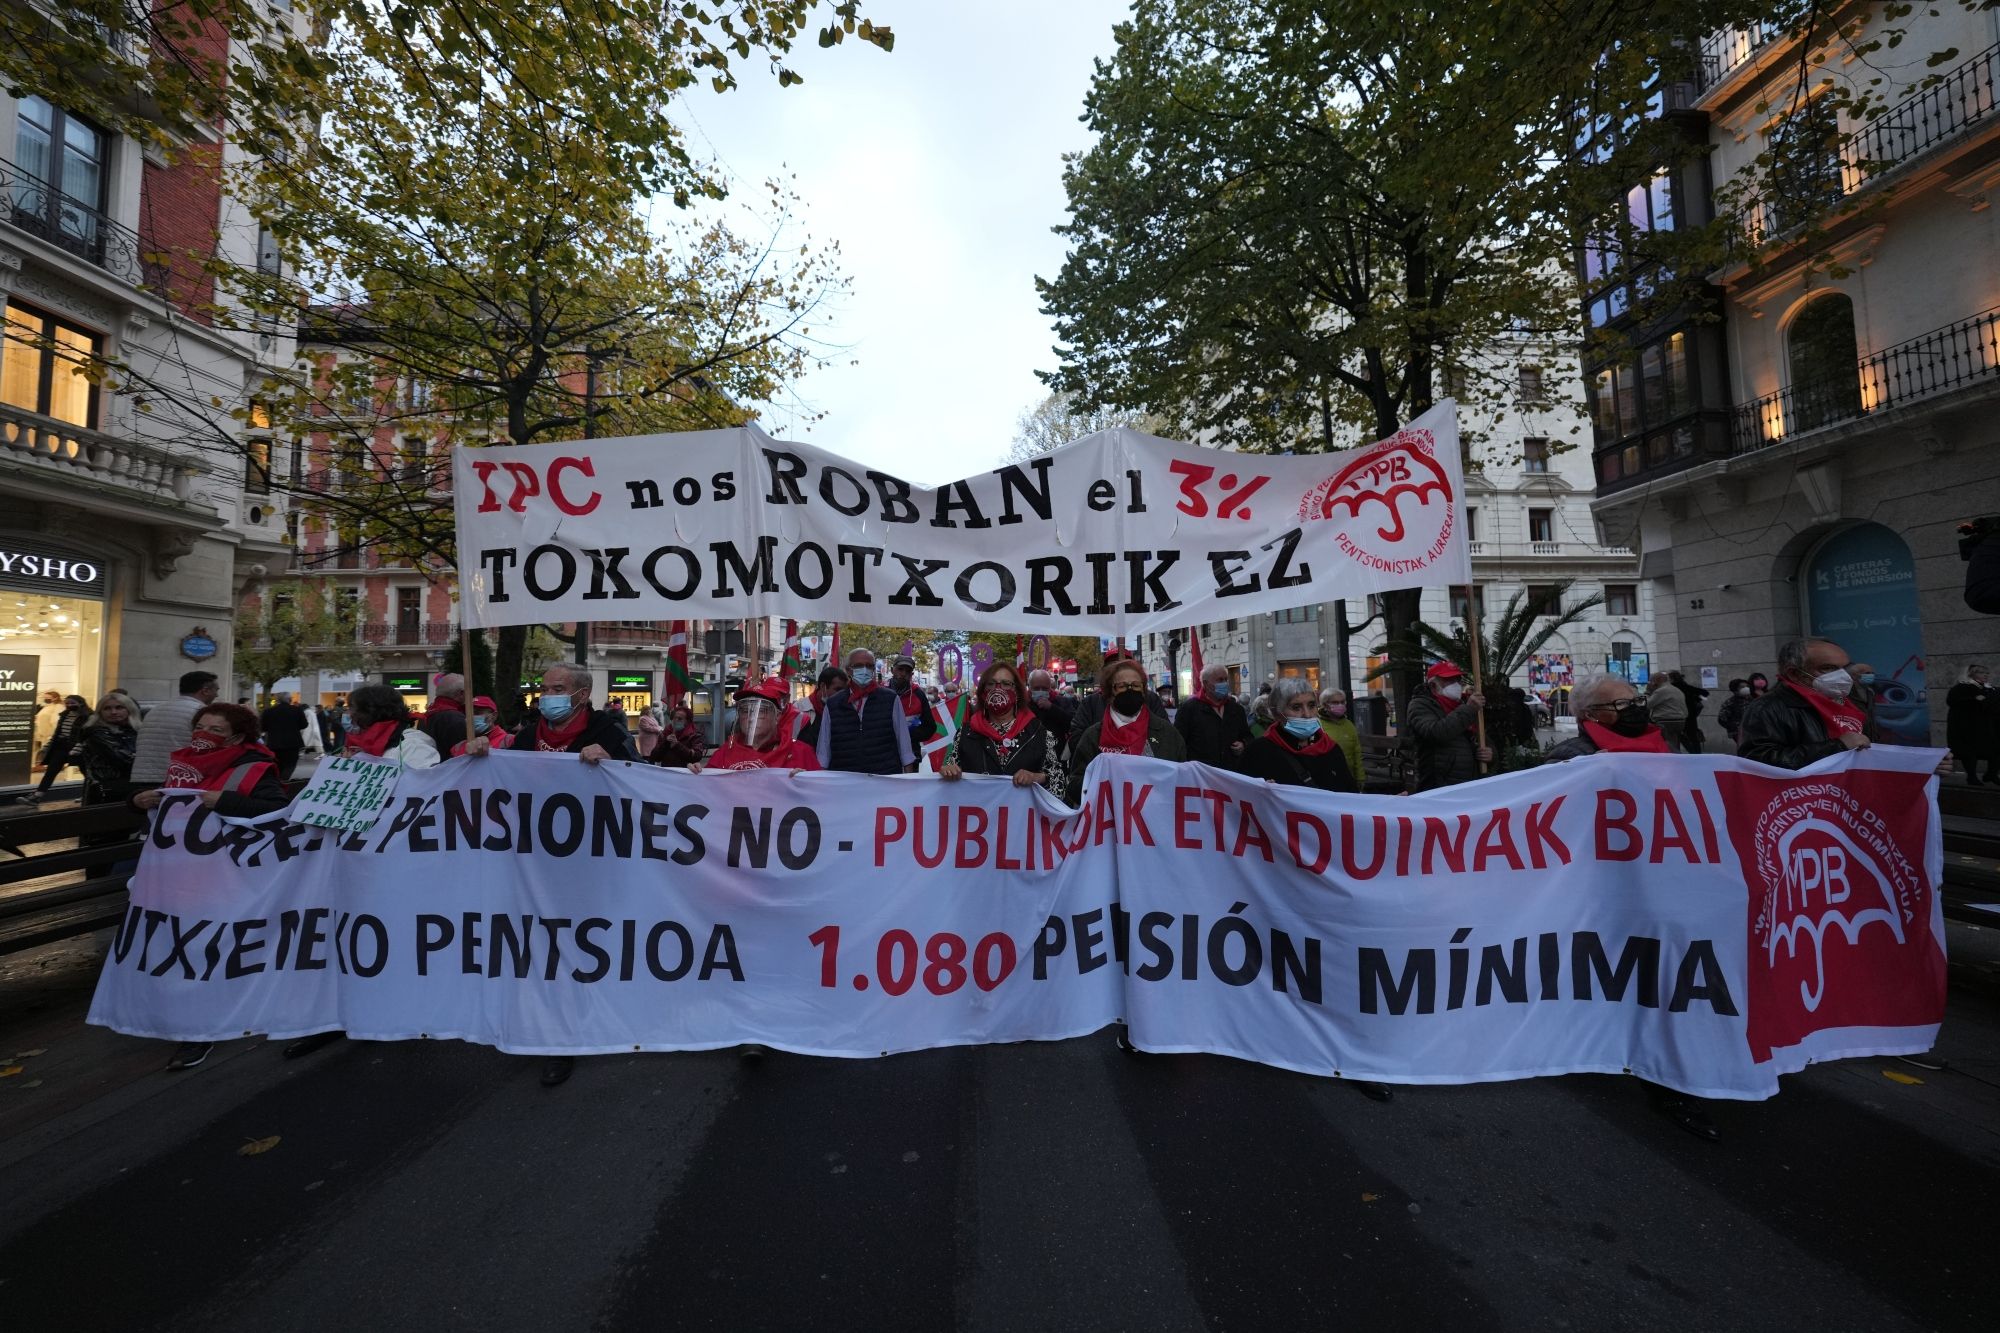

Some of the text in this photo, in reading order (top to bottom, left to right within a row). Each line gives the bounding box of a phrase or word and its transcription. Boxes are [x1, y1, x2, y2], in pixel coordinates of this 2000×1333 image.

[473, 457, 602, 516] IPC
[625, 471, 736, 509] nos
[762, 449, 1053, 529] ROBAN
[1087, 470, 1147, 514] el
[1169, 459, 1272, 520] 3%
[0, 553, 97, 582] YSHO
[481, 528, 1312, 616] TOKOMOTXORIK EZ
[1834, 558, 1892, 573] CARTERAS
[1844, 567, 1888, 579] FONDOS
[1835, 580, 1849, 588] DE
[328, 757, 399, 779] LEVANTA
[356, 774, 385, 788] DEL
[301, 789, 382, 811] DEFIENDE
[341, 808, 360, 819] TU
[374, 788, 710, 866] PENSIONES
[727, 806, 821, 871] NO
[1174, 787, 1275, 864] ETA
[1285, 794, 1572, 881] DUINAK
[1595, 788, 1721, 864] BAI
[1784, 846, 1851, 912] MPB
[416, 912, 746, 984] PENTSIOA
[808, 925, 1017, 997] 1.080
[1358, 927, 1740, 1017] MÍNIMA
